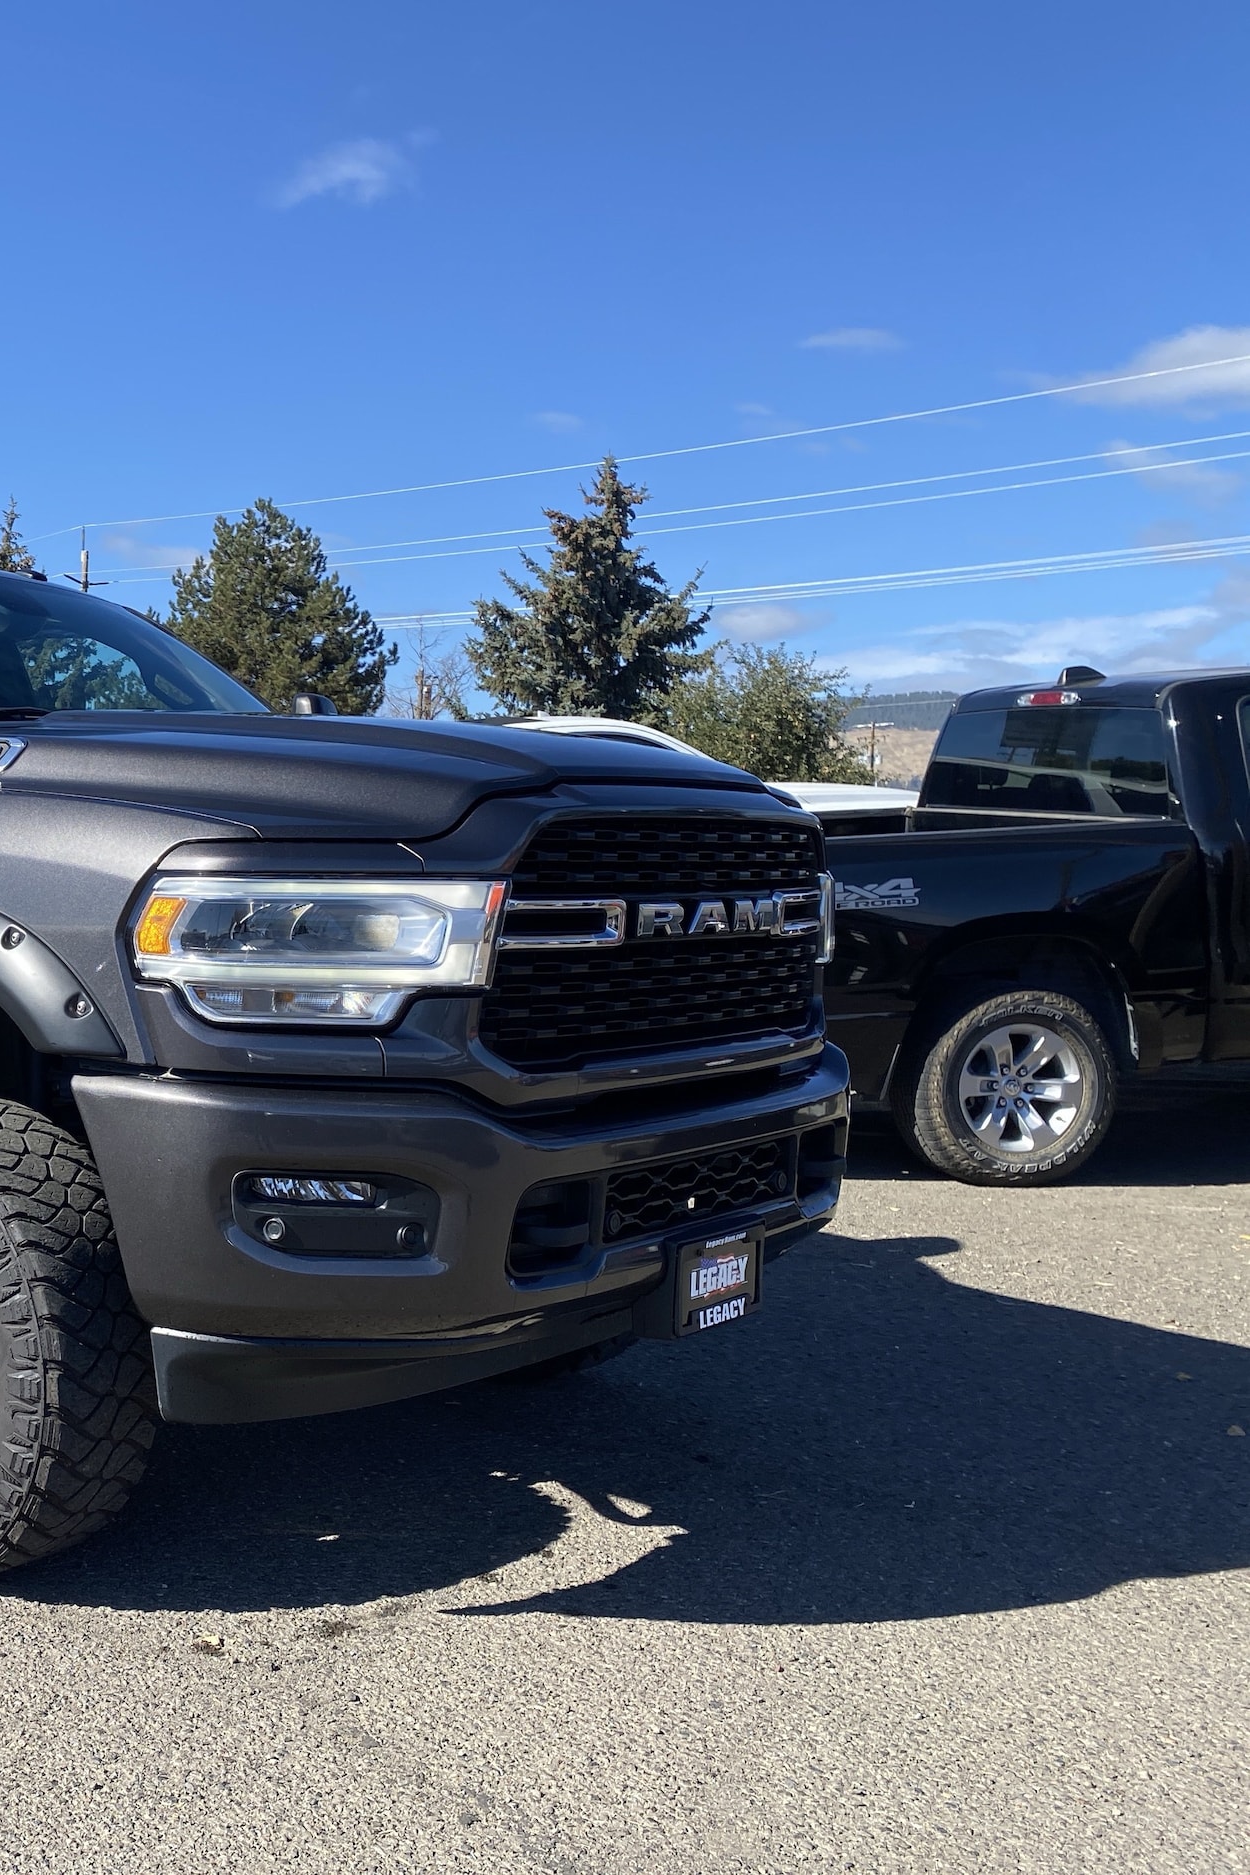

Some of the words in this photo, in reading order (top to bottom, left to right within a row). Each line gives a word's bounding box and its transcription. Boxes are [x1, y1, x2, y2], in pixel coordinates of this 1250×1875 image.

[636, 899, 774, 938] RAM
[690, 1255, 749, 1298] LEGACY
[699, 1297, 746, 1330] LEGACY
